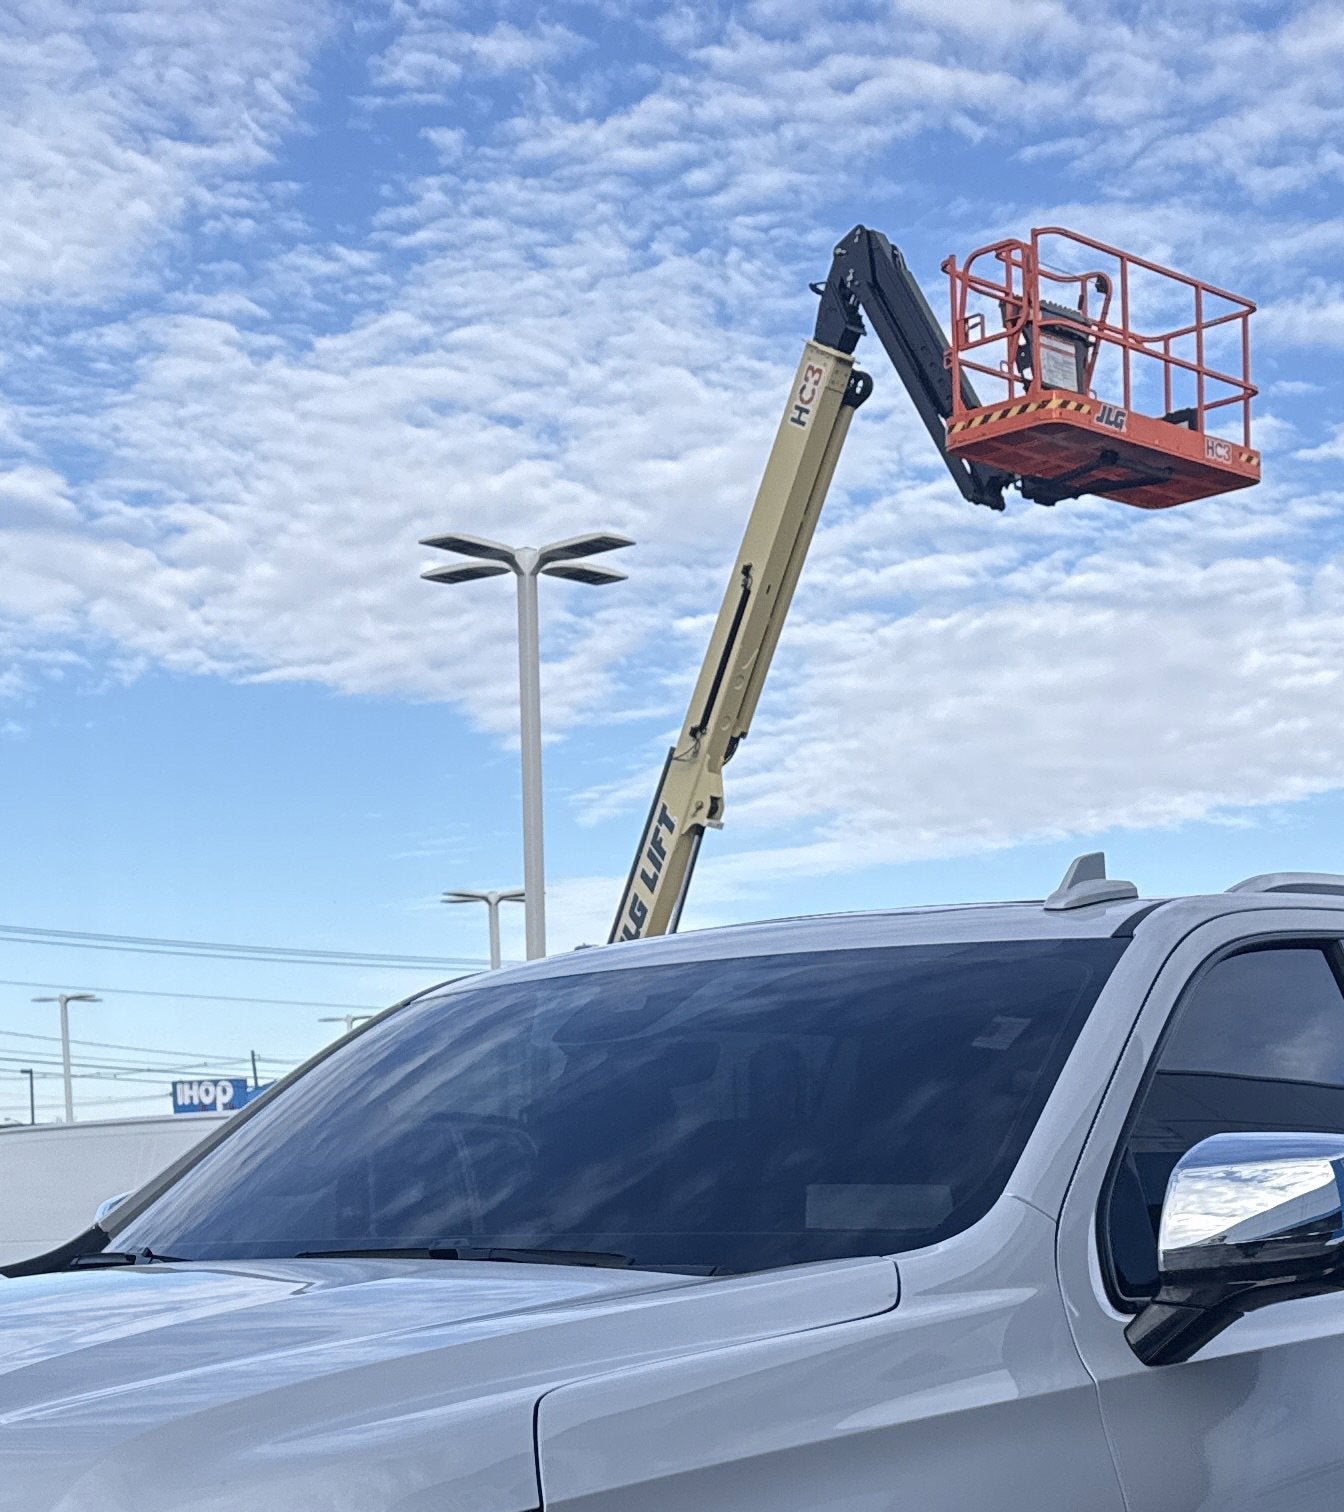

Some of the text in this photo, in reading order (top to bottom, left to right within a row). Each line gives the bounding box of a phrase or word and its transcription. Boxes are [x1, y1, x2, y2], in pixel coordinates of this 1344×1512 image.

[790, 364, 823, 427] HC3
[1095, 404, 1127, 431] JLG
[1206, 438, 1232, 462] HC3
[619, 802, 676, 942] LG LIFT
